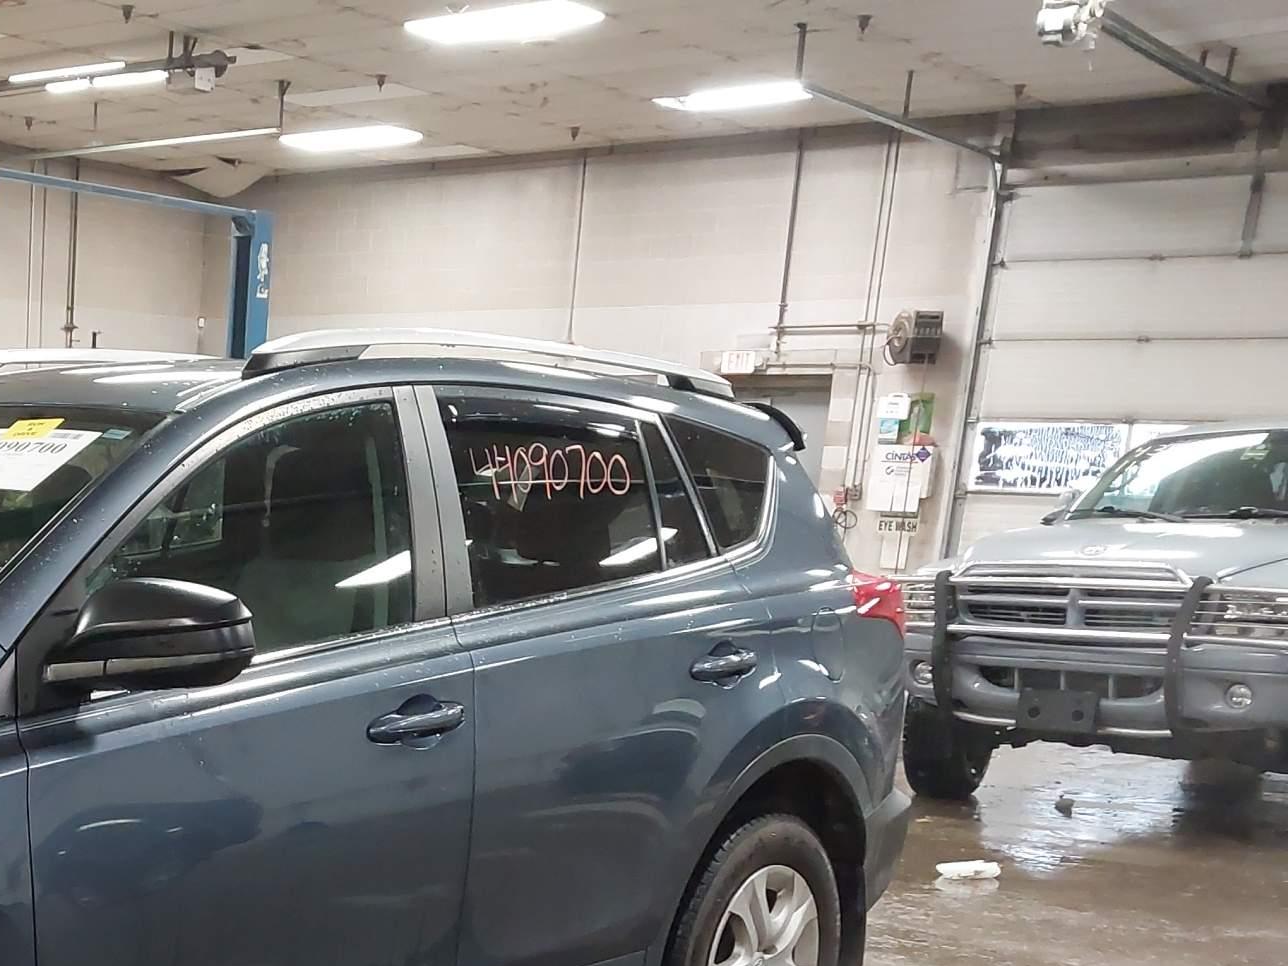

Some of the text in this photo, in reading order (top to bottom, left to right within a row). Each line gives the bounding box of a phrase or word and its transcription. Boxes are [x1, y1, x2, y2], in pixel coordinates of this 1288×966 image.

[728, 352, 752, 371] EXIT
[469, 442, 631, 504] 44090700
[878, 520, 918, 533] EYE WASH
